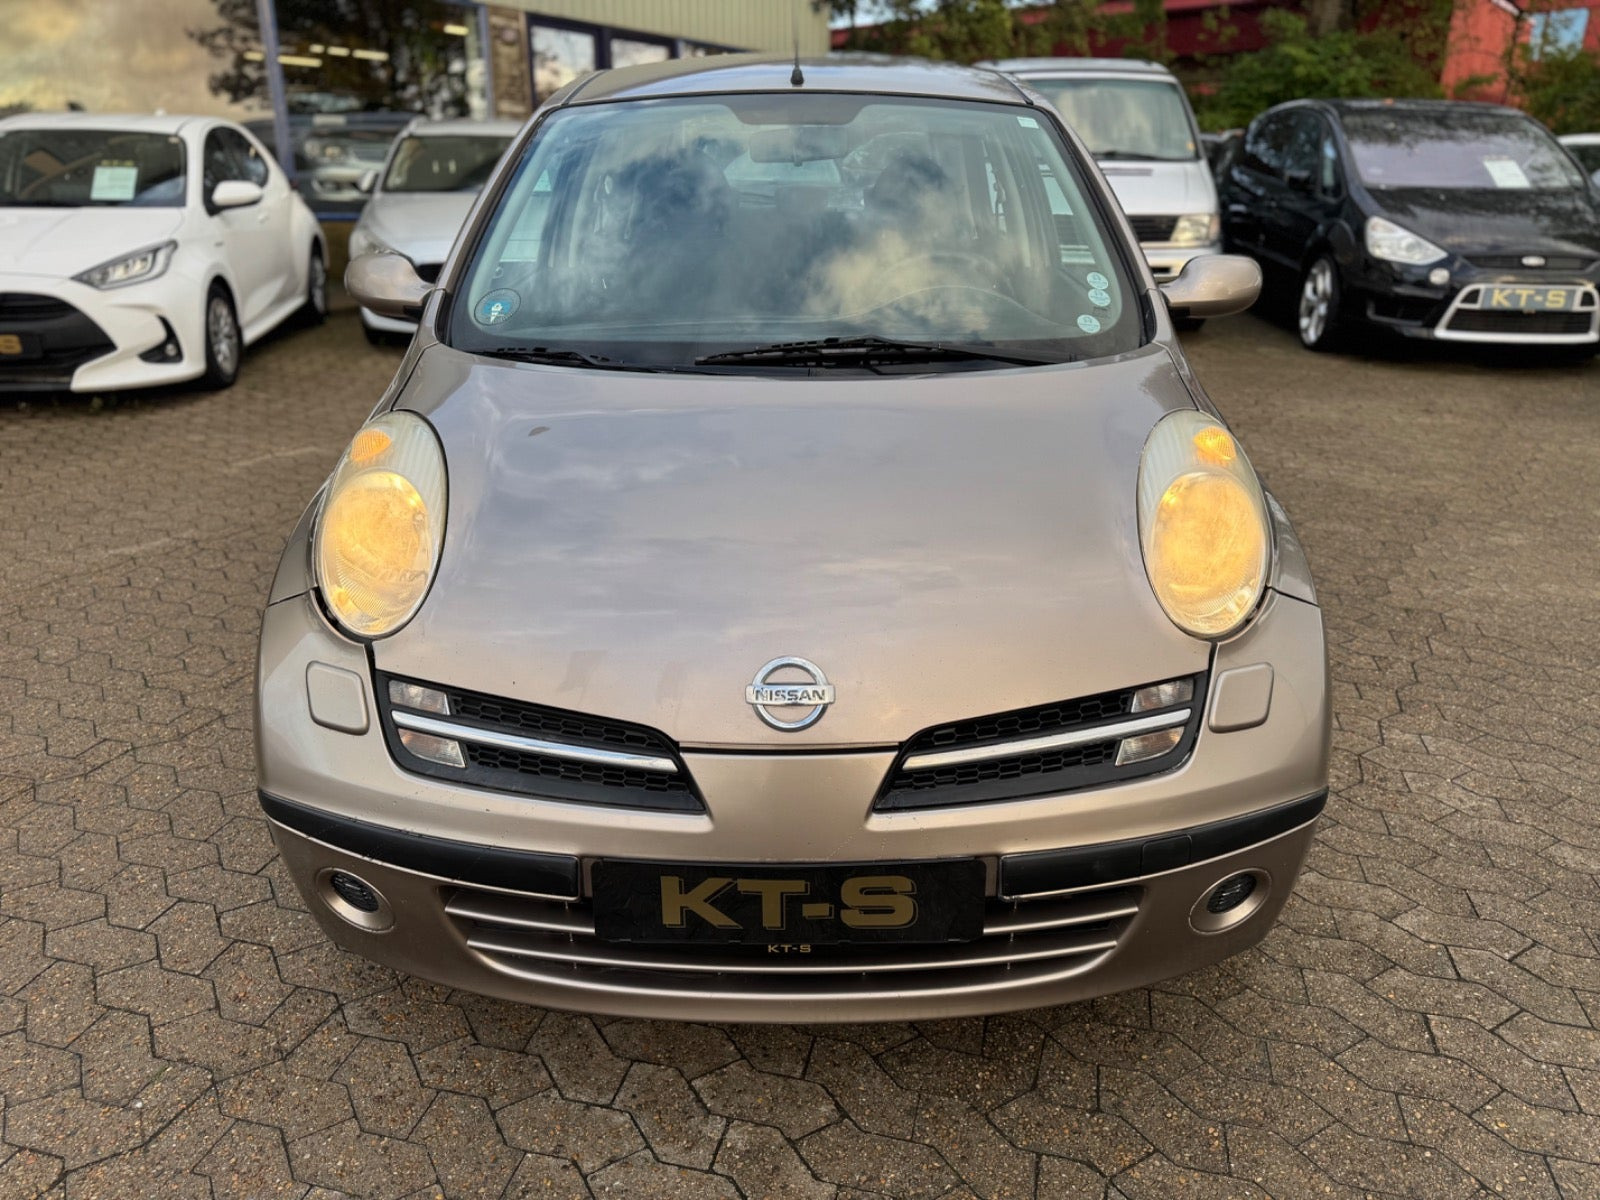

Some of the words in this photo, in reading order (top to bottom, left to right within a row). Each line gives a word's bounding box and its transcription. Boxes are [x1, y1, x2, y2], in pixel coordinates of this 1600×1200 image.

[1491, 288, 1568, 308] KT-S
[754, 686, 826, 701] NISSAN
[660, 875, 918, 930] KT-S
[767, 944, 811, 953] KT-S
